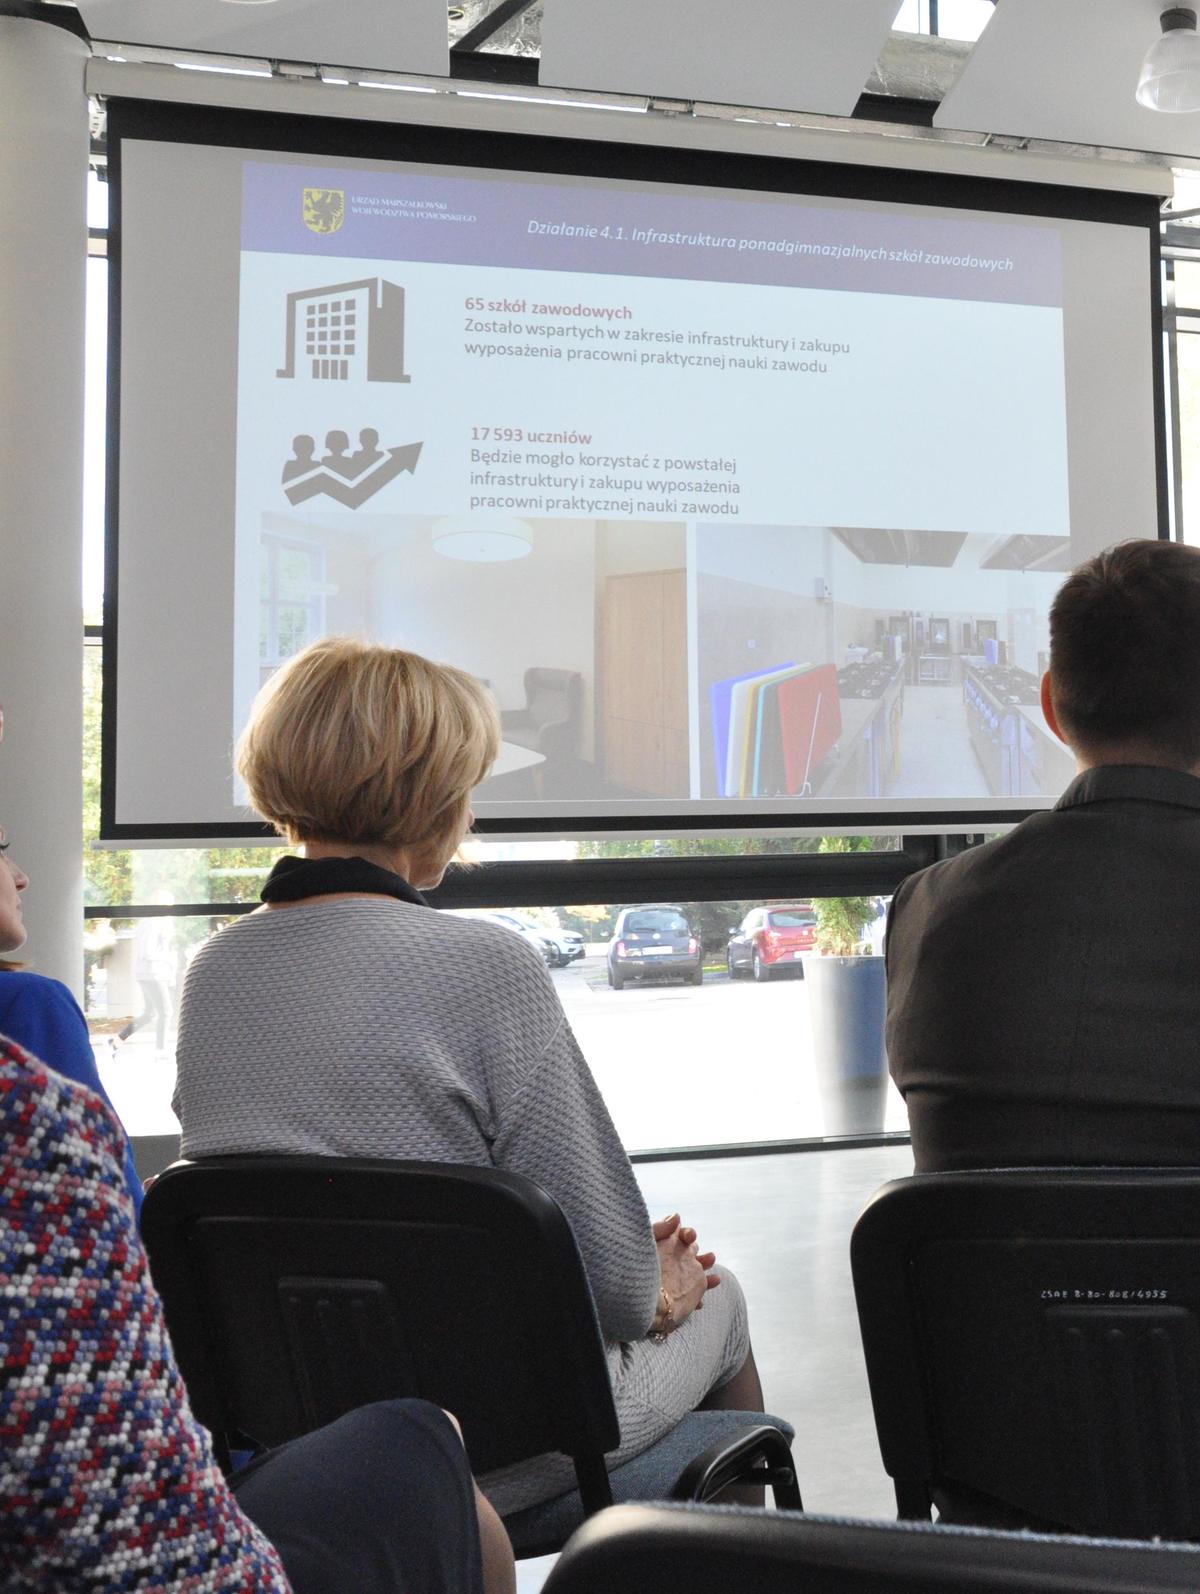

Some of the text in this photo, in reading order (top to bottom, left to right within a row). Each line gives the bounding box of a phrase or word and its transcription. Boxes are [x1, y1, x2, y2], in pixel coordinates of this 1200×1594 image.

[527, 219, 1013, 272] Działanie 4.1. Infrastruktura ponadgimnazjalnych szkół zawodowych
[465, 297, 632, 321] 65 szkół zawodowych
[464, 318, 850, 356] Zostało wspartych w zakresie infrastruktury i zakupu
[464, 342, 828, 374] wyposażenia pracowni praktycznej nauki zawodu
[471, 426, 592, 445] 17 593 uczniów
[470, 448, 737, 474] Będzie mogło korzystać z powstałej
[470, 471, 741, 495] infrastruktury i zakupu wyposażenia
[470, 494, 739, 515] pracowni praktycznej nauki zawodu
